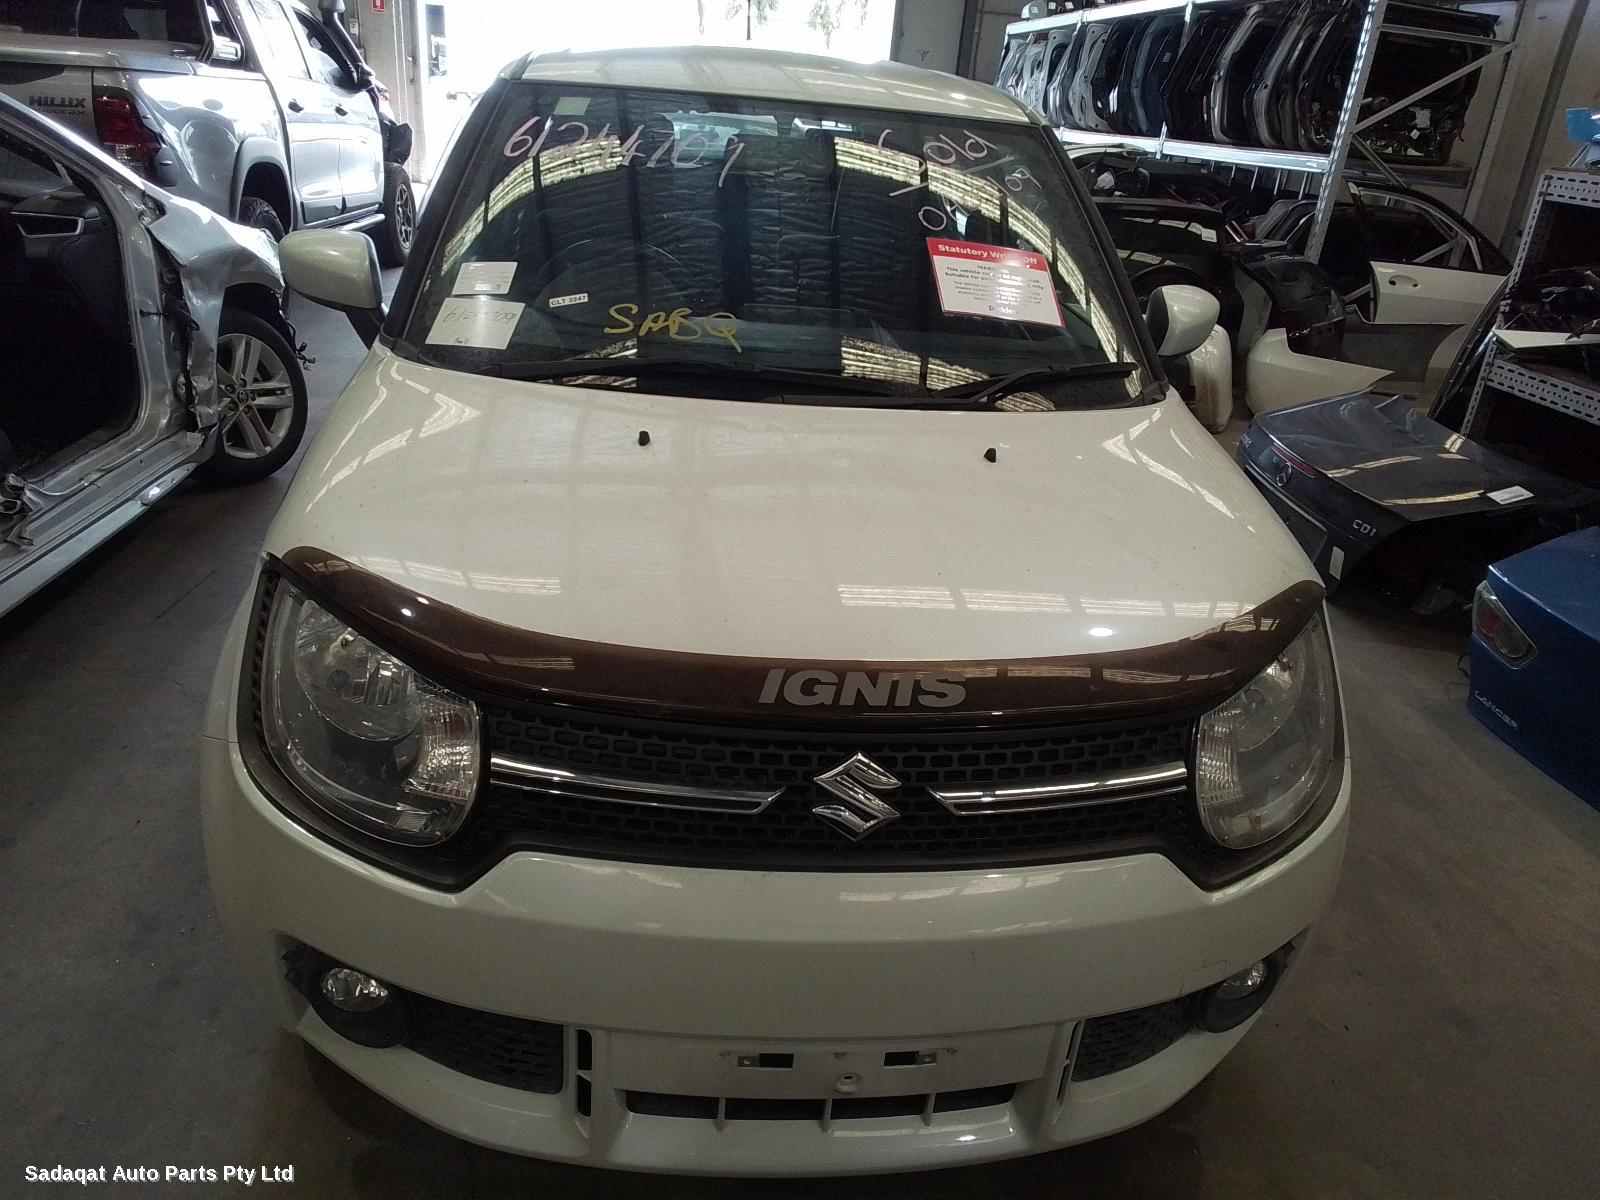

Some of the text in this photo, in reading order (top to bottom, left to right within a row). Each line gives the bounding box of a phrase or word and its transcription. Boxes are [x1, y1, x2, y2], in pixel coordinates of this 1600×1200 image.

[29, 95, 87, 108] HILUX
[938, 244, 989, 258] Statutory
[1352, 519, 1377, 537] CDI
[758, 668, 967, 708] IGNIS
